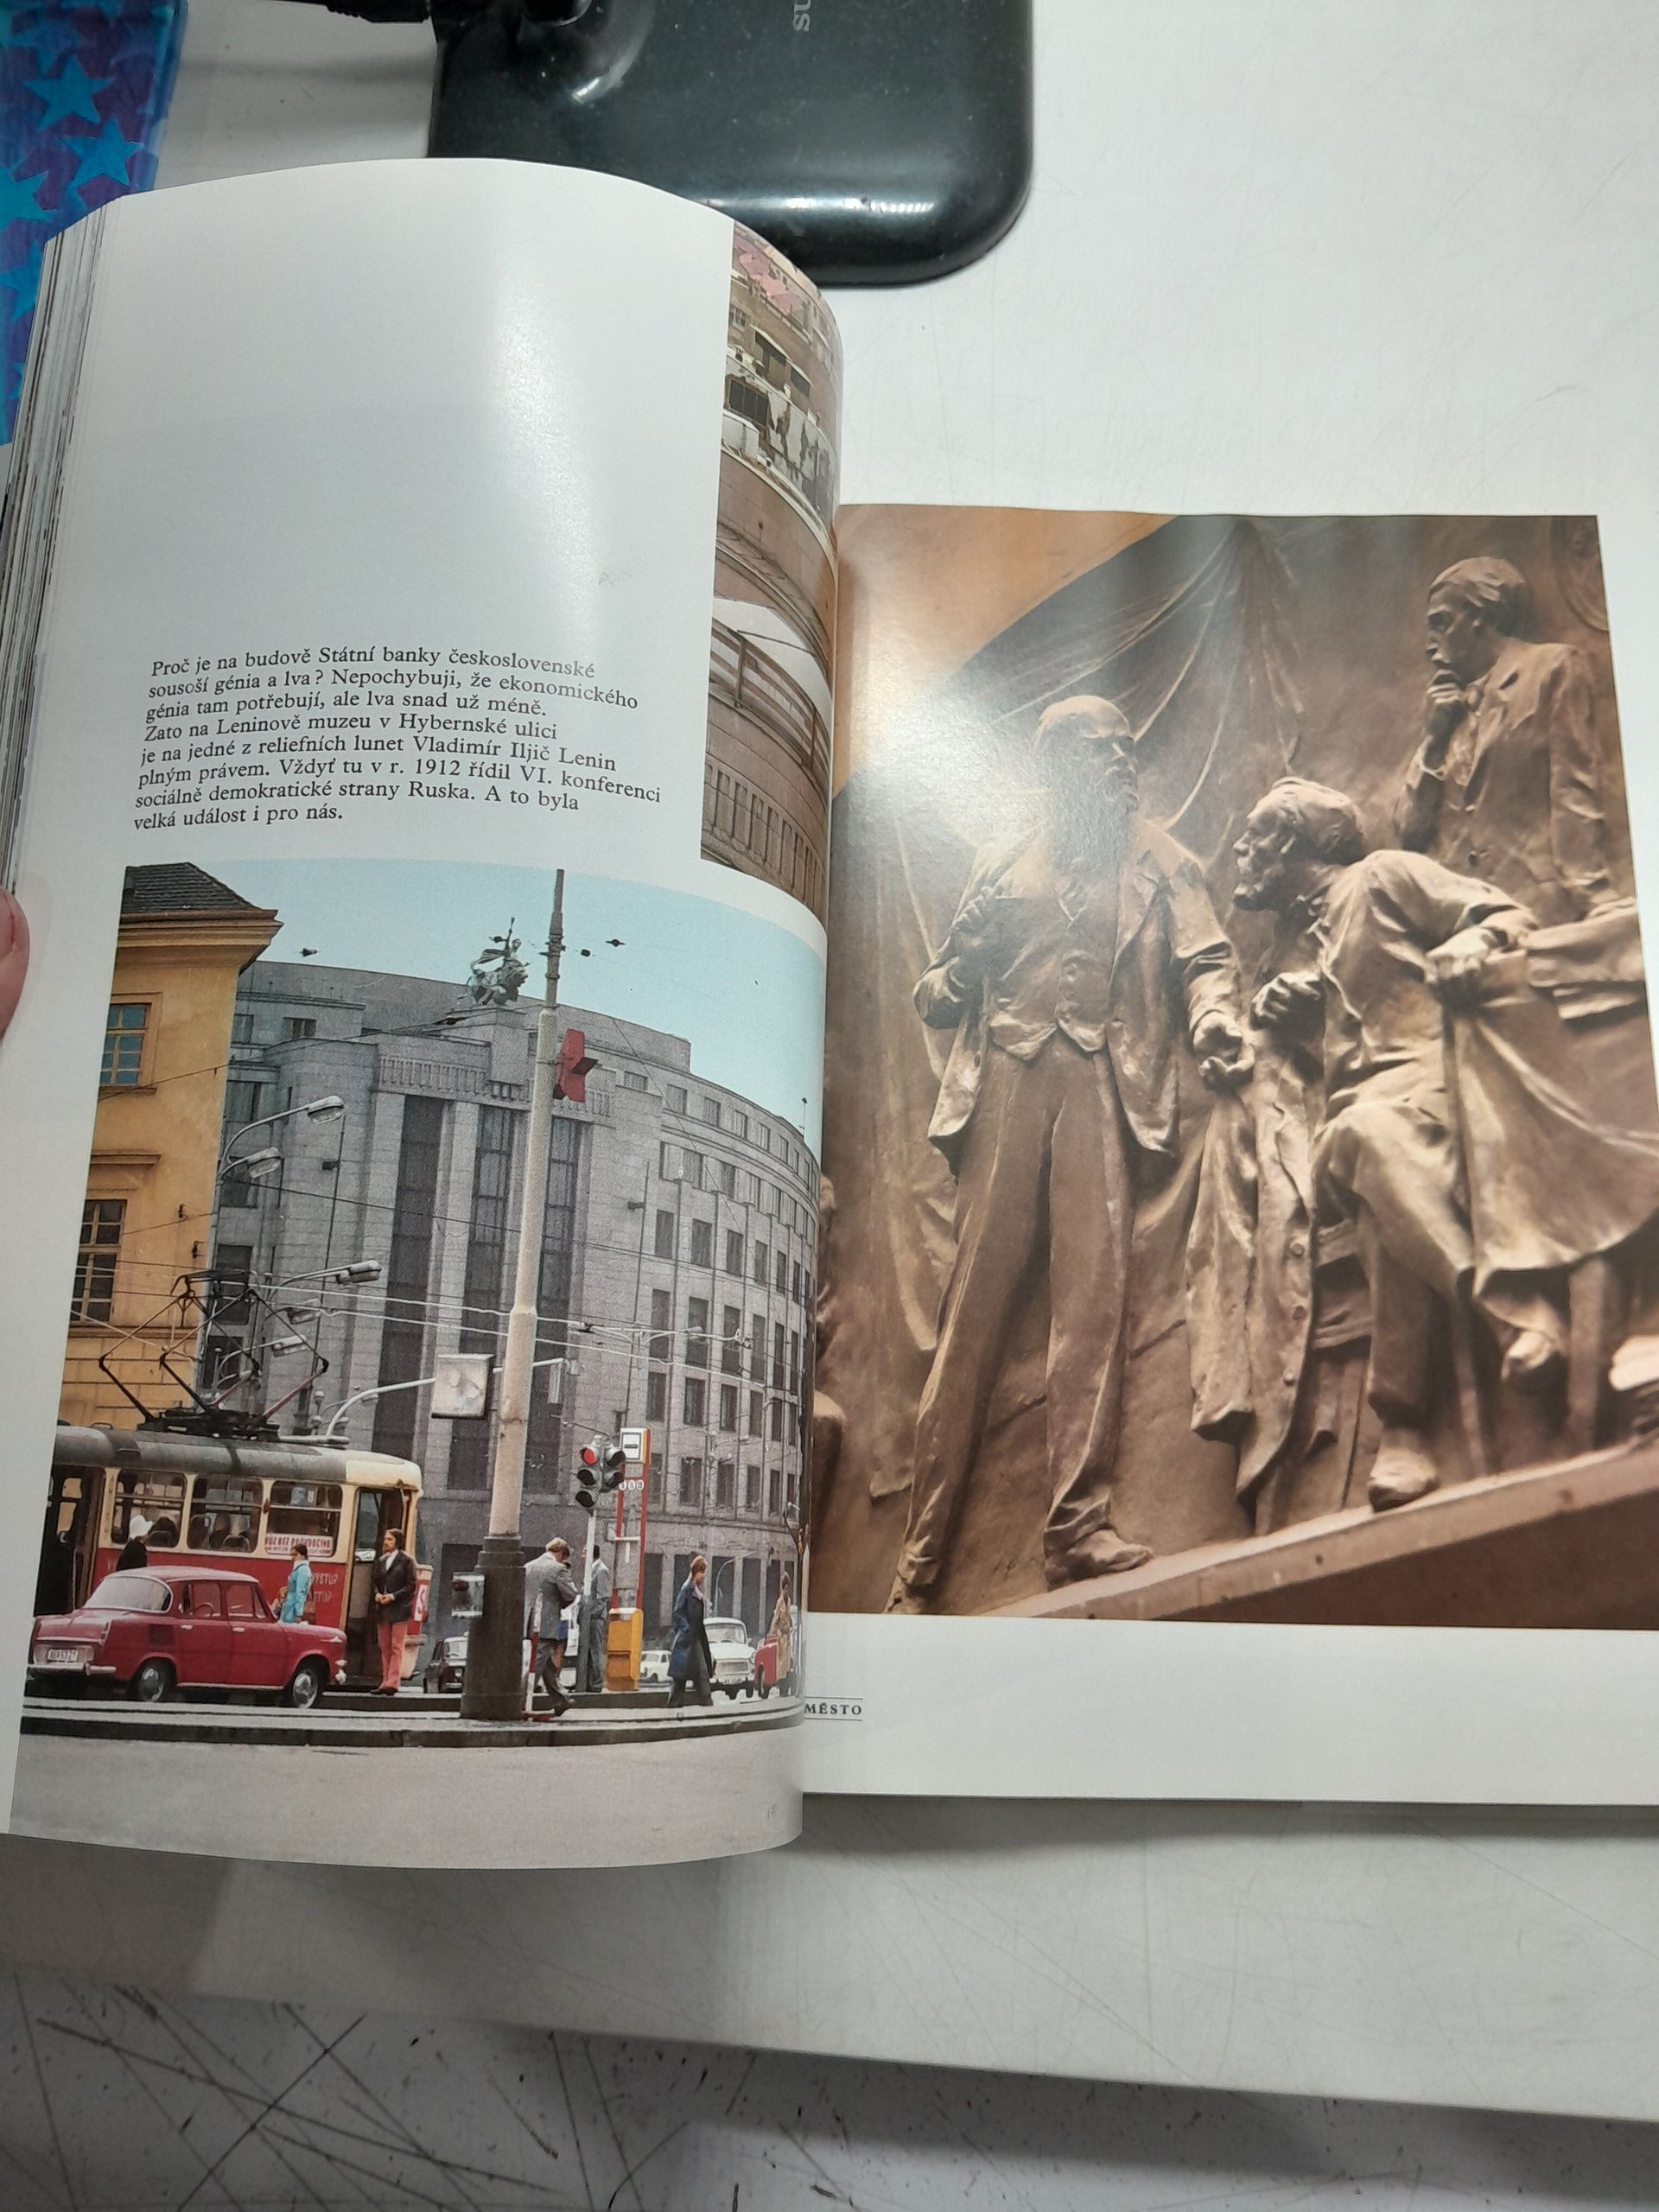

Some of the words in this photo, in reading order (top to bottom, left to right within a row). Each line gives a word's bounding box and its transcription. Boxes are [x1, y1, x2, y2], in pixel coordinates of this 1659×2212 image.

[150, 658, 190, 677] Proč
[194, 656, 211, 676] je
[216, 658, 238, 670] na
[245, 648, 311, 667] budově
[318, 645, 376, 664] Státní
[383, 645, 442, 667] banky
[448, 648, 595, 678] československé
[148, 676, 209, 698] sousoší
[213, 673, 261, 696] génia
[267, 676, 277, 688] a
[330, 667, 461, 690] Nepochybuji,
[470, 671, 492, 688] že
[499, 674, 638, 709] ekonomického
[145, 702, 189, 724] génia
[197, 701, 229, 715] tam
[235, 690, 325, 715] potřebují,
[333, 690, 360, 707] ale
[366, 690, 395, 706] lva
[402, 691, 448, 708] snad
[455, 694, 480, 709] už
[486, 697, 546, 716] méně.
[143, 725, 182, 741] Zato
[188, 724, 209, 737] na
[215, 714, 301, 735] Leninově
[307, 716, 372, 729] muzeu
[379, 717, 391, 728] v
[397, 712, 507, 734] Hybernské
[514, 721, 557, 740] ulici
[140, 748, 156, 768] je
[161, 748, 181, 762] na
[187, 740, 236, 763] jedné
[241, 743, 252, 755] z
[257, 734, 346, 754] reliefních
[353, 734, 404, 751] lunet
[412, 735, 502, 756] Vladimír
[509, 741, 550, 763] Iljič
[557, 747, 616, 772] Lenin
[135, 786, 202, 808] sociálně
[208, 779, 333, 801] demokratické
[339, 783, 401, 801] strany
[407, 780, 475, 800] Ruska.
[484, 785, 502, 802] A
[509, 790, 530, 804] to
[537, 790, 579, 811] byla
[137, 766, 192, 790] plným
[198, 761, 270, 785] právem.
[278, 757, 336, 779] Vždyť
[342, 760, 363, 773] tu
[371, 761, 383, 773] v
[389, 762, 404, 774] r.
[415, 758, 461, 776] 1912
[467, 760, 511, 780] řídil
[519, 764, 552, 785] VI.
[561, 770, 660, 803] konferenci
[134, 810, 176, 830] velká
[183, 807, 247, 826] událost
[252, 804, 259, 822] i
[265, 808, 299, 825] pro
[305, 802, 343, 820] nás.
[804, 1702, 862, 1715] MĚSTO
